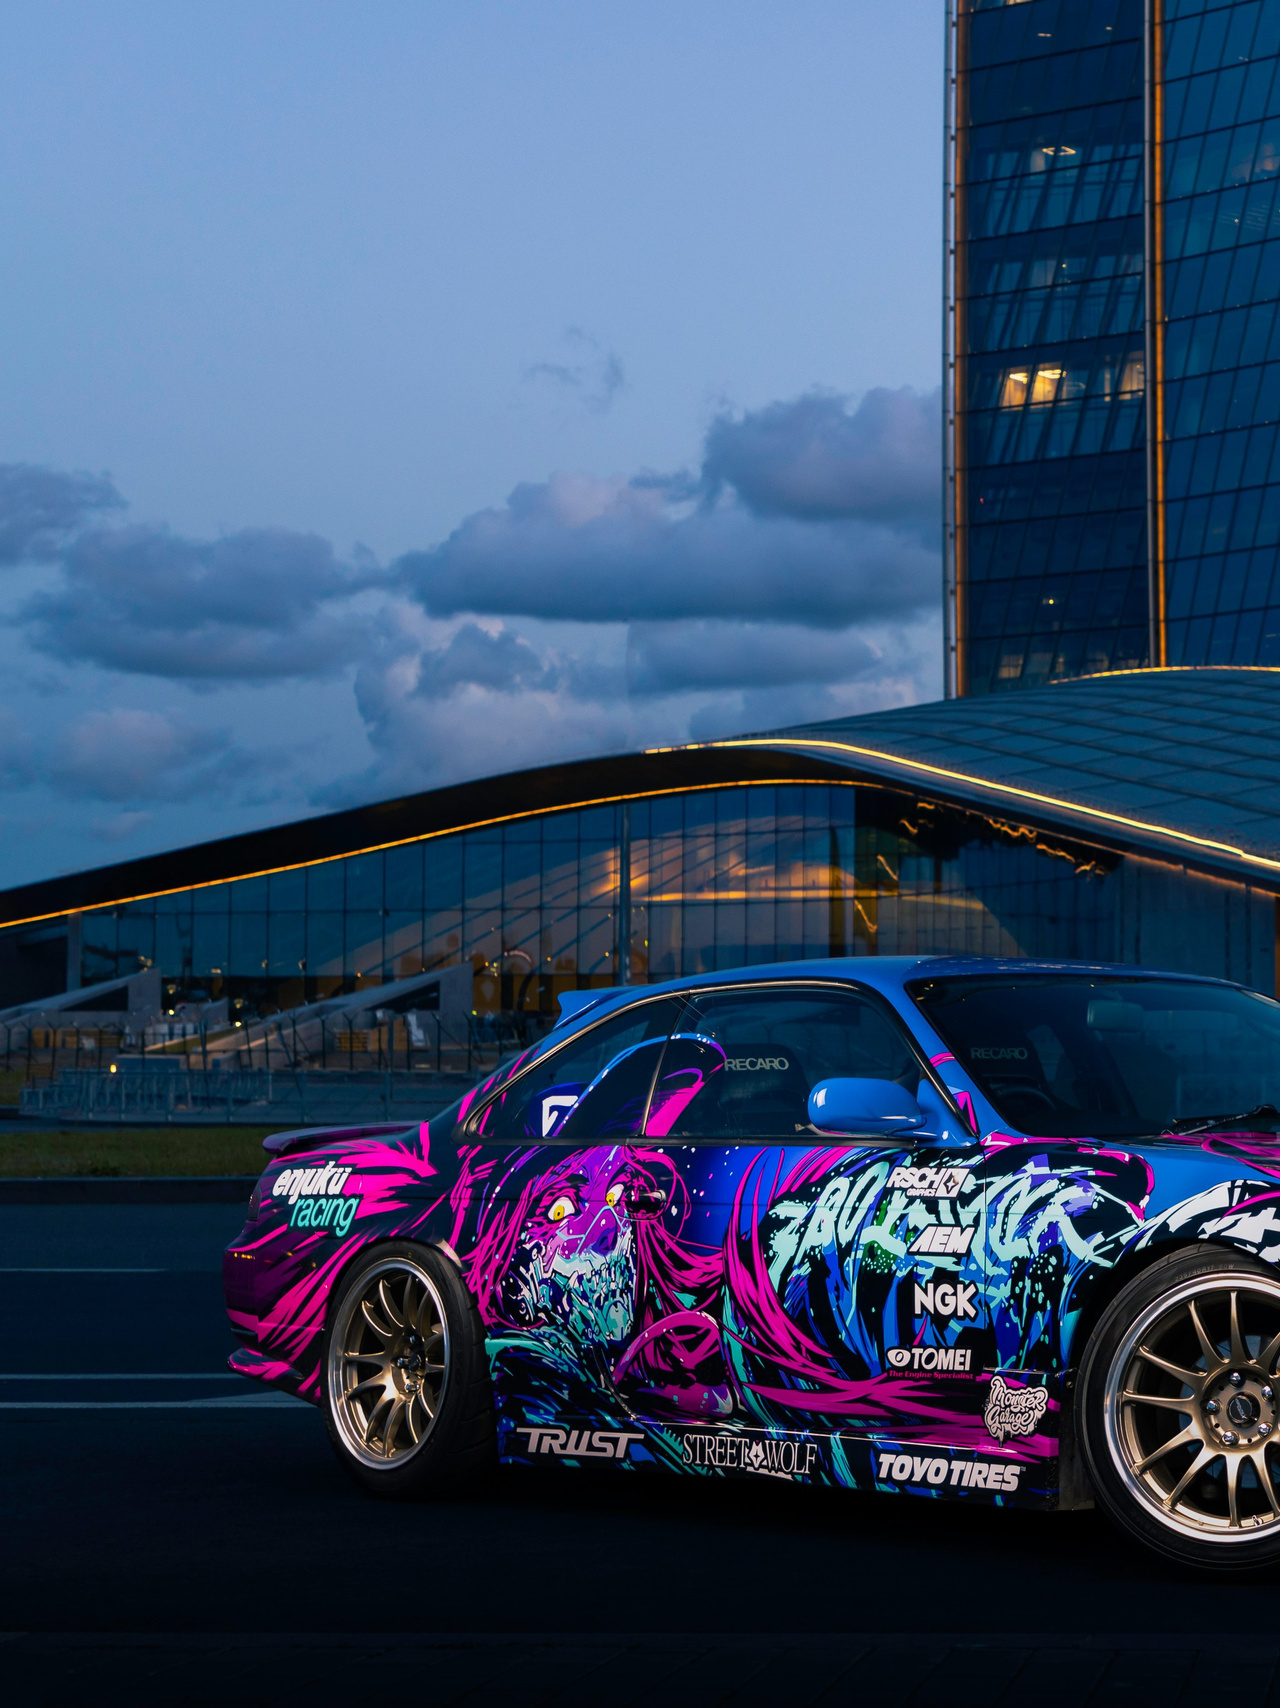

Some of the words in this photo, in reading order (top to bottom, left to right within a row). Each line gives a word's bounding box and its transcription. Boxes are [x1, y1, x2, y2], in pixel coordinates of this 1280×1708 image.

[724, 1057, 789, 1071] RECARO
[971, 1047, 1028, 1061] RECARO
[885, 1166, 948, 1188] RSCH
[289, 1198, 359, 1237] racing
[908, 1225, 975, 1254] AEM
[914, 1282, 977, 1318] NGK
[911, 1347, 972, 1371] TOMEI
[889, 1370, 903, 1378] The
[904, 1371, 932, 1379] Engine
[933, 1371, 974, 1380] Specialist
[987, 1405, 1035, 1435] Garage
[516, 1427, 645, 1459] TRUST
[682, 1433, 749, 1468] STREET
[764, 1439, 818, 1474] WOLF
[878, 1453, 949, 1485] TOYO
[949, 1460, 1021, 1492] TIRES
